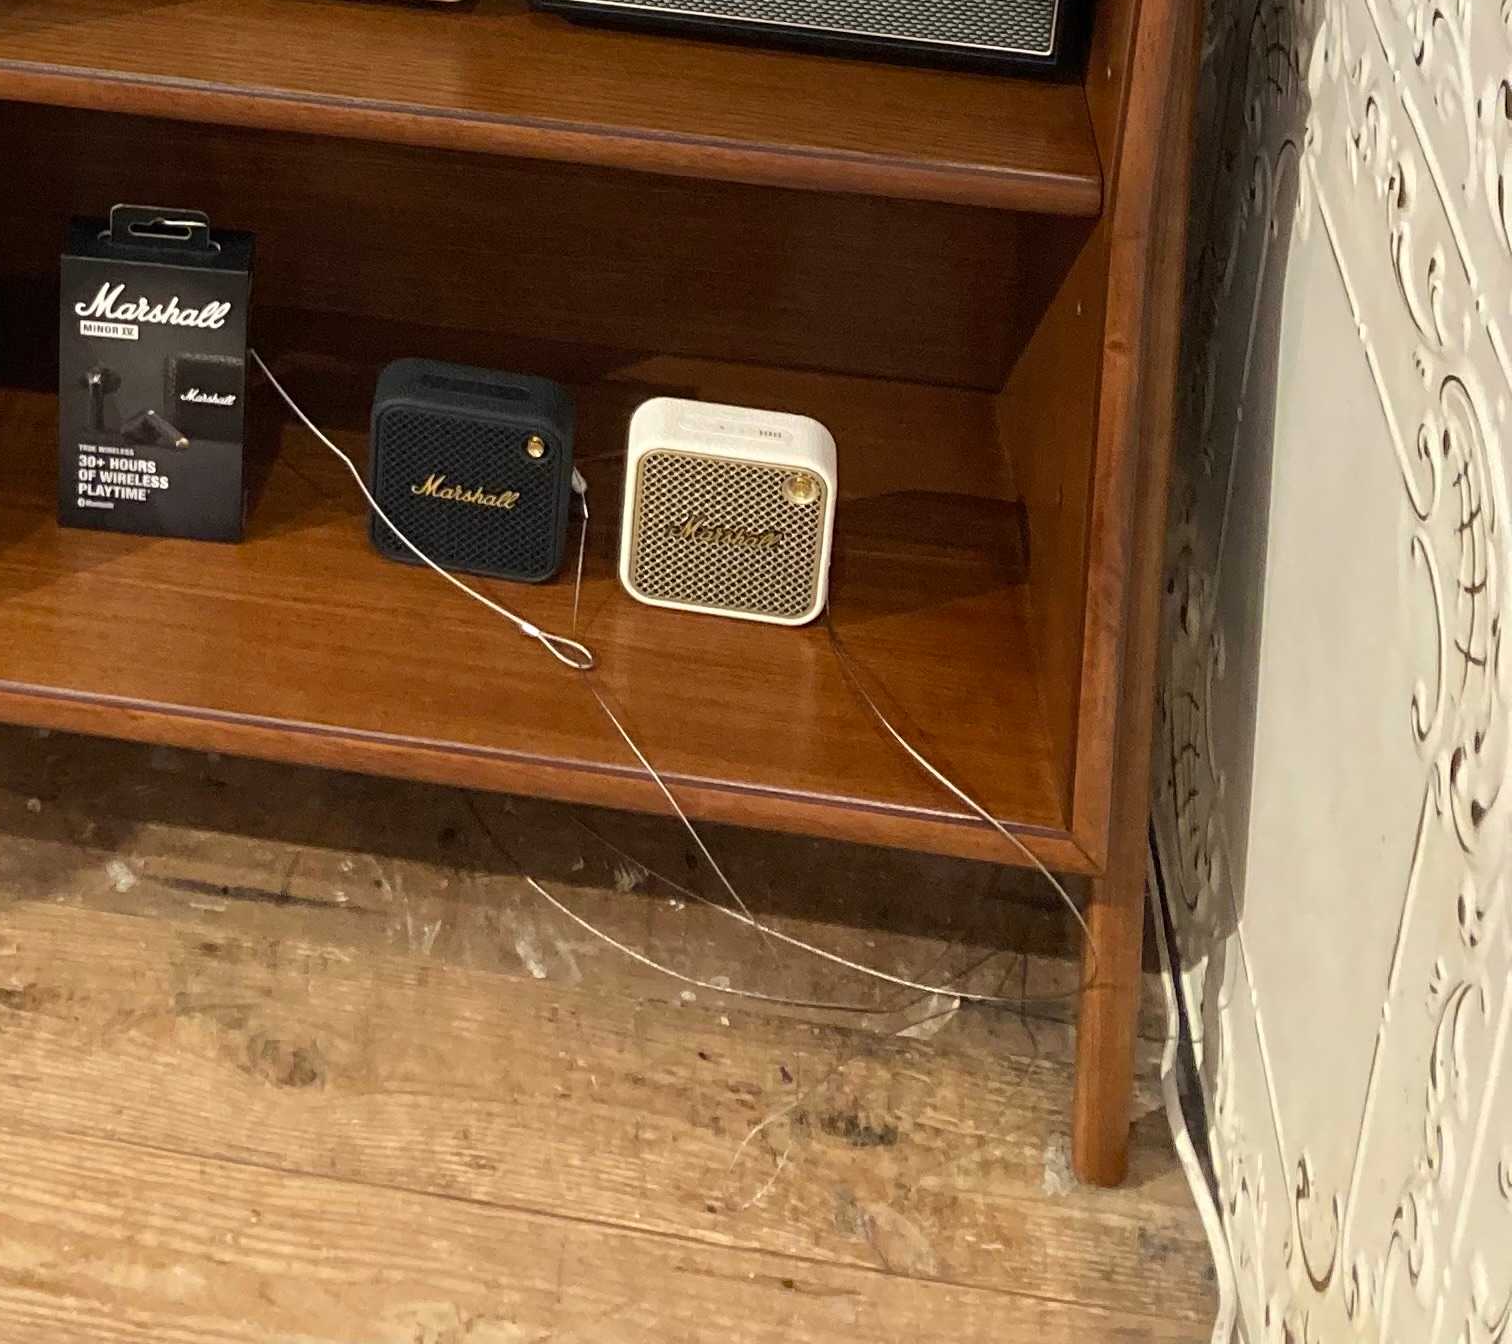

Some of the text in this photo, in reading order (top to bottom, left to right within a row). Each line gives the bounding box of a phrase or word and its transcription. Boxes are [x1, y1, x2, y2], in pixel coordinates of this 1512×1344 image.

[74, 281, 232, 330] Marshall
[82, 323, 120, 335] MINOR
[180, 388, 236, 406] Marshall
[79, 454, 156, 474] 30+ HOURS
[78, 468, 169, 490] OF WIRELESS
[410, 473, 521, 510] Marshall
